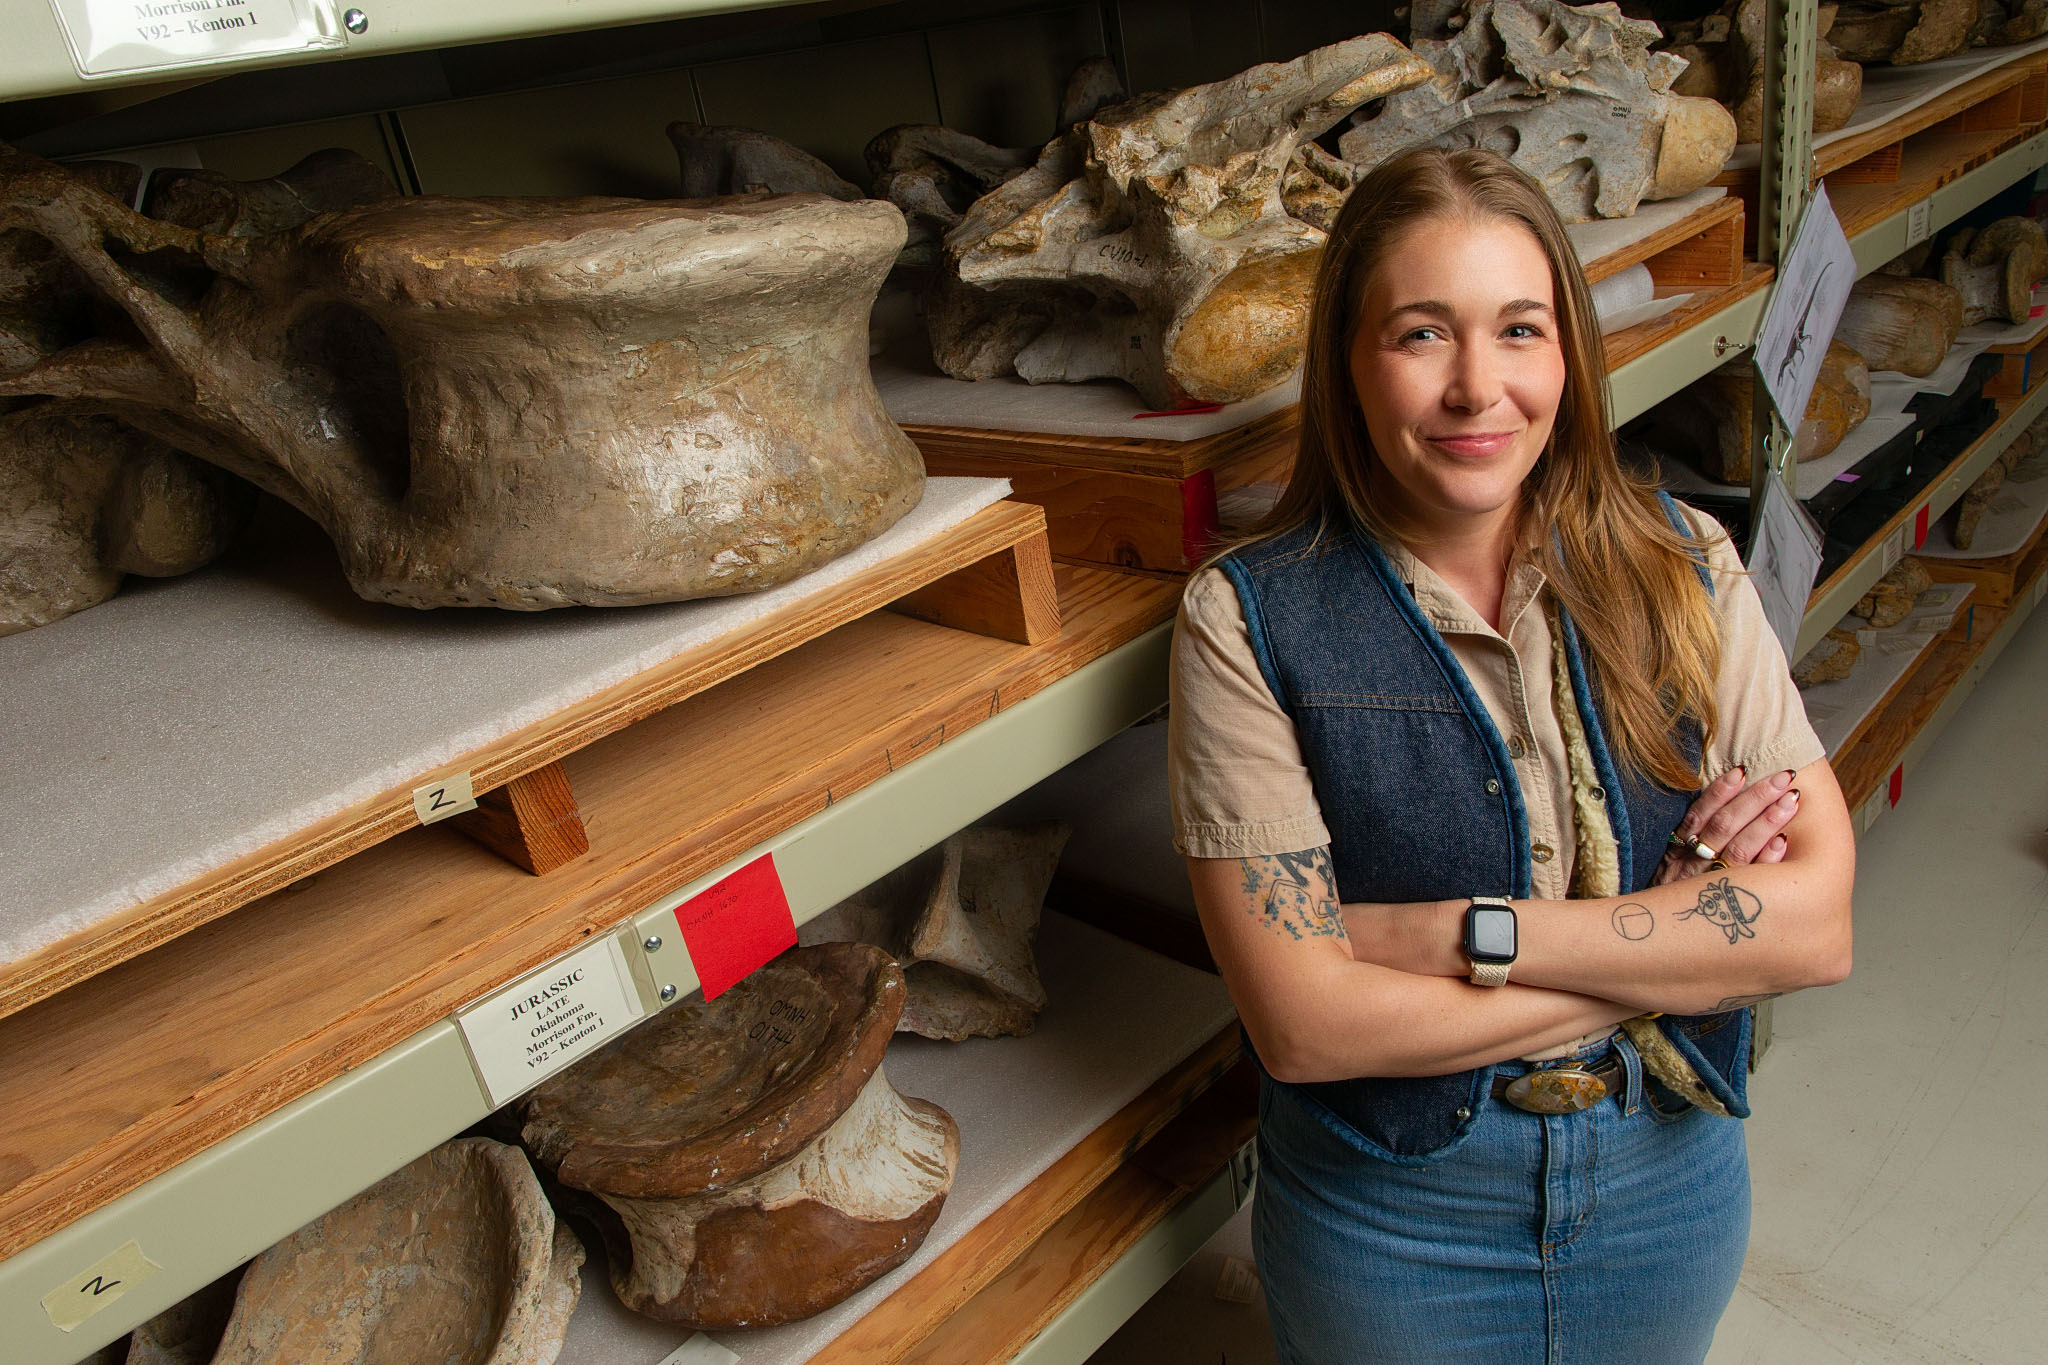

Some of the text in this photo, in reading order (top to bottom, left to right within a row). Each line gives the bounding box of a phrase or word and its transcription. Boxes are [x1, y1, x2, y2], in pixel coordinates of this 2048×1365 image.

[134, 0, 211, 19] Morrison
[136, 24, 171, 41] V92
[187, 16, 245, 34] Kenton
[248, 11, 258, 25] 1
[511, 968, 585, 1021] JURASSIC
[536, 995, 570, 1020] LATE
[530, 1003, 585, 1038] Oklahoma
[769, 1000, 811, 1025] OMNH
[526, 1011, 598, 1056] Morrison Fm.
[527, 1051, 550, 1069] V92
[559, 1023, 597, 1051] Kenton
[599, 1017, 605, 1027] 1
